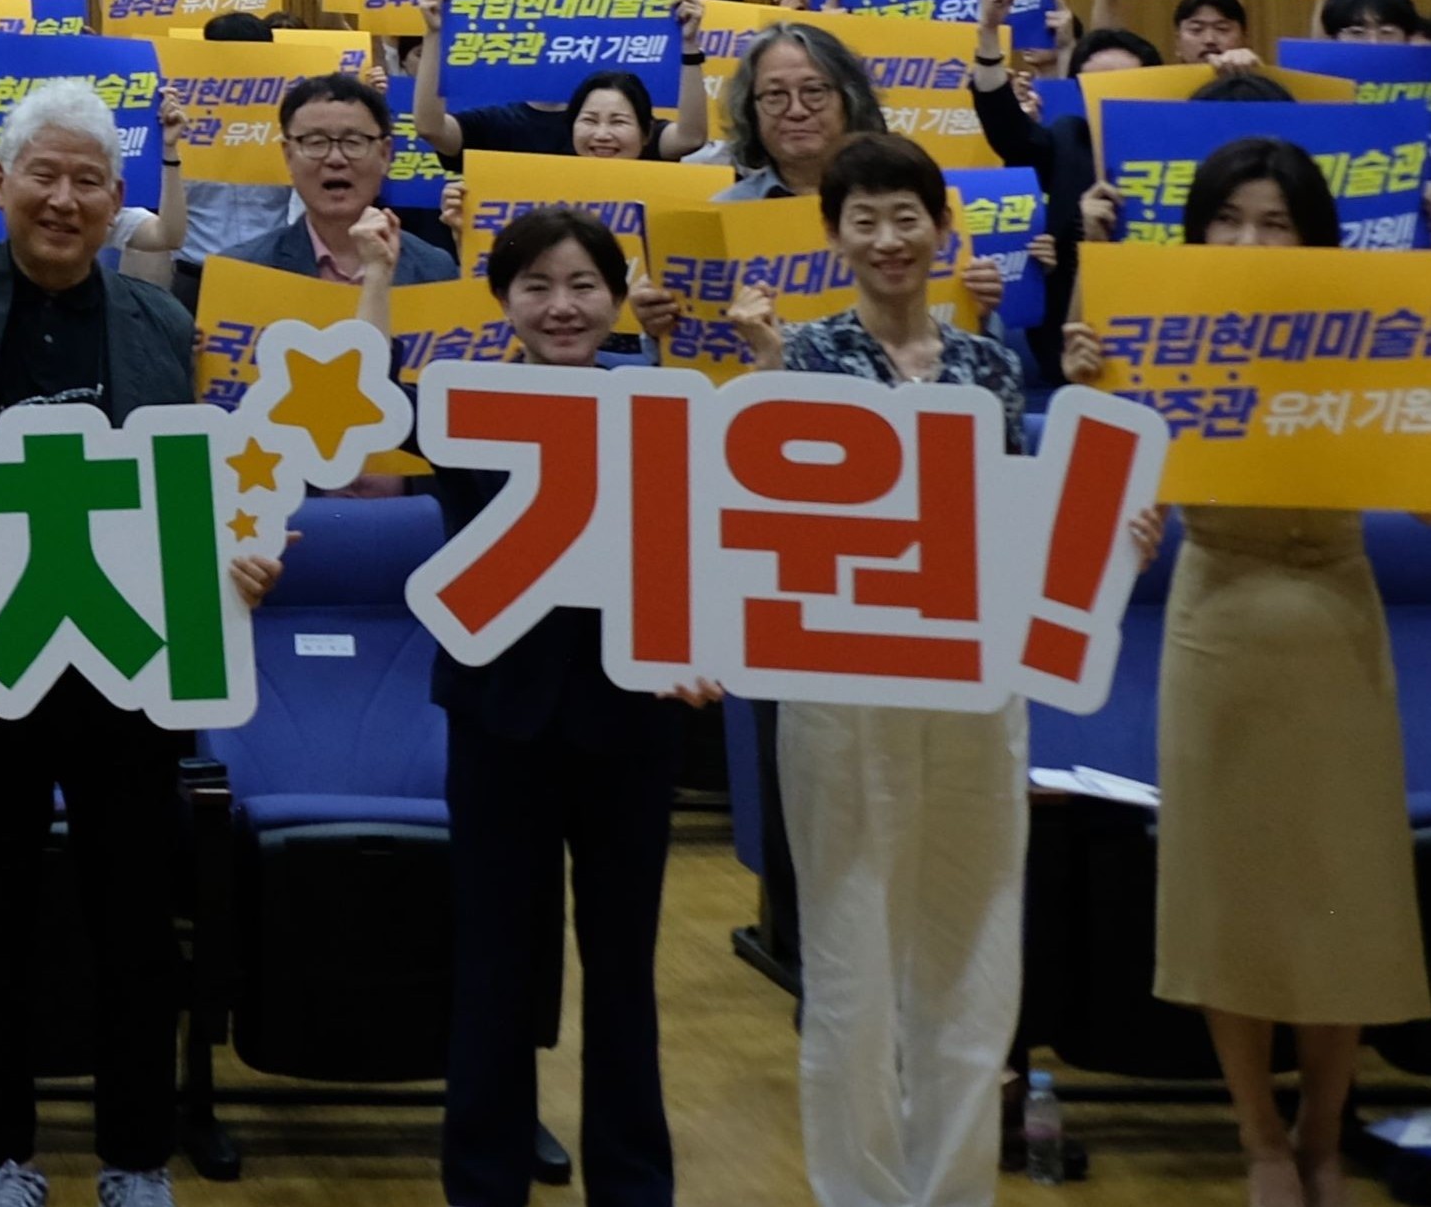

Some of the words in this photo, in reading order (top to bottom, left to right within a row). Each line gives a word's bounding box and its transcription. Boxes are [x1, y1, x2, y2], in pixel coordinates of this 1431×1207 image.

[447, 32, 547, 66] 광주관
[546, 36, 601, 64] 유치
[601, 34, 669, 64] 기원!!
[223, 122, 271, 147] 유치
[1101, 308, 1431, 366] 국립현대미술
[1263, 390, 1348, 437] 유치
[439, 391, 1139, 682] 기원!
